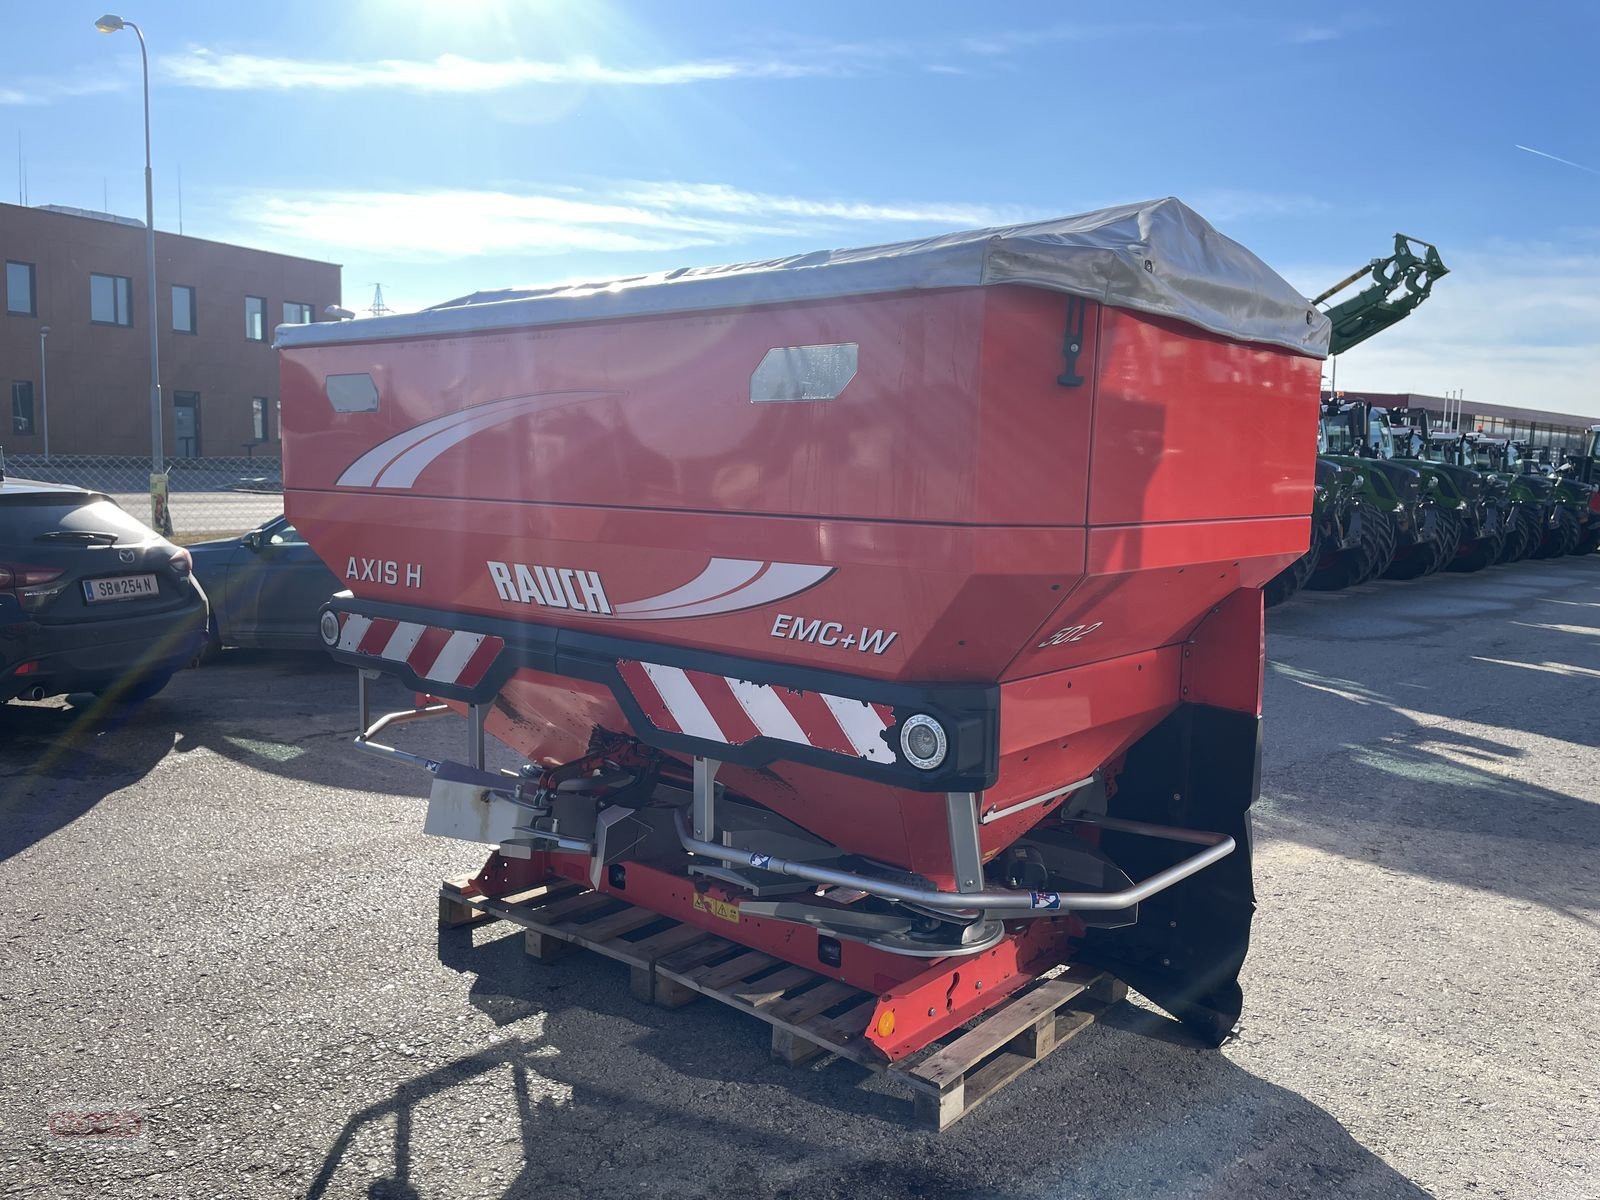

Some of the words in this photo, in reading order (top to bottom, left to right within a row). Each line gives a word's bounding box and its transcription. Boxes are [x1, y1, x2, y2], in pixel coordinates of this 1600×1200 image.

[98, 582, 114, 596] SB
[121, 579, 142, 594] 254
[143, 578, 151, 592] N
[346, 556, 398, 585] AXIS
[406, 564, 421, 588] H
[486, 560, 613, 616] RAUCH
[770, 613, 898, 655] EMC+W
